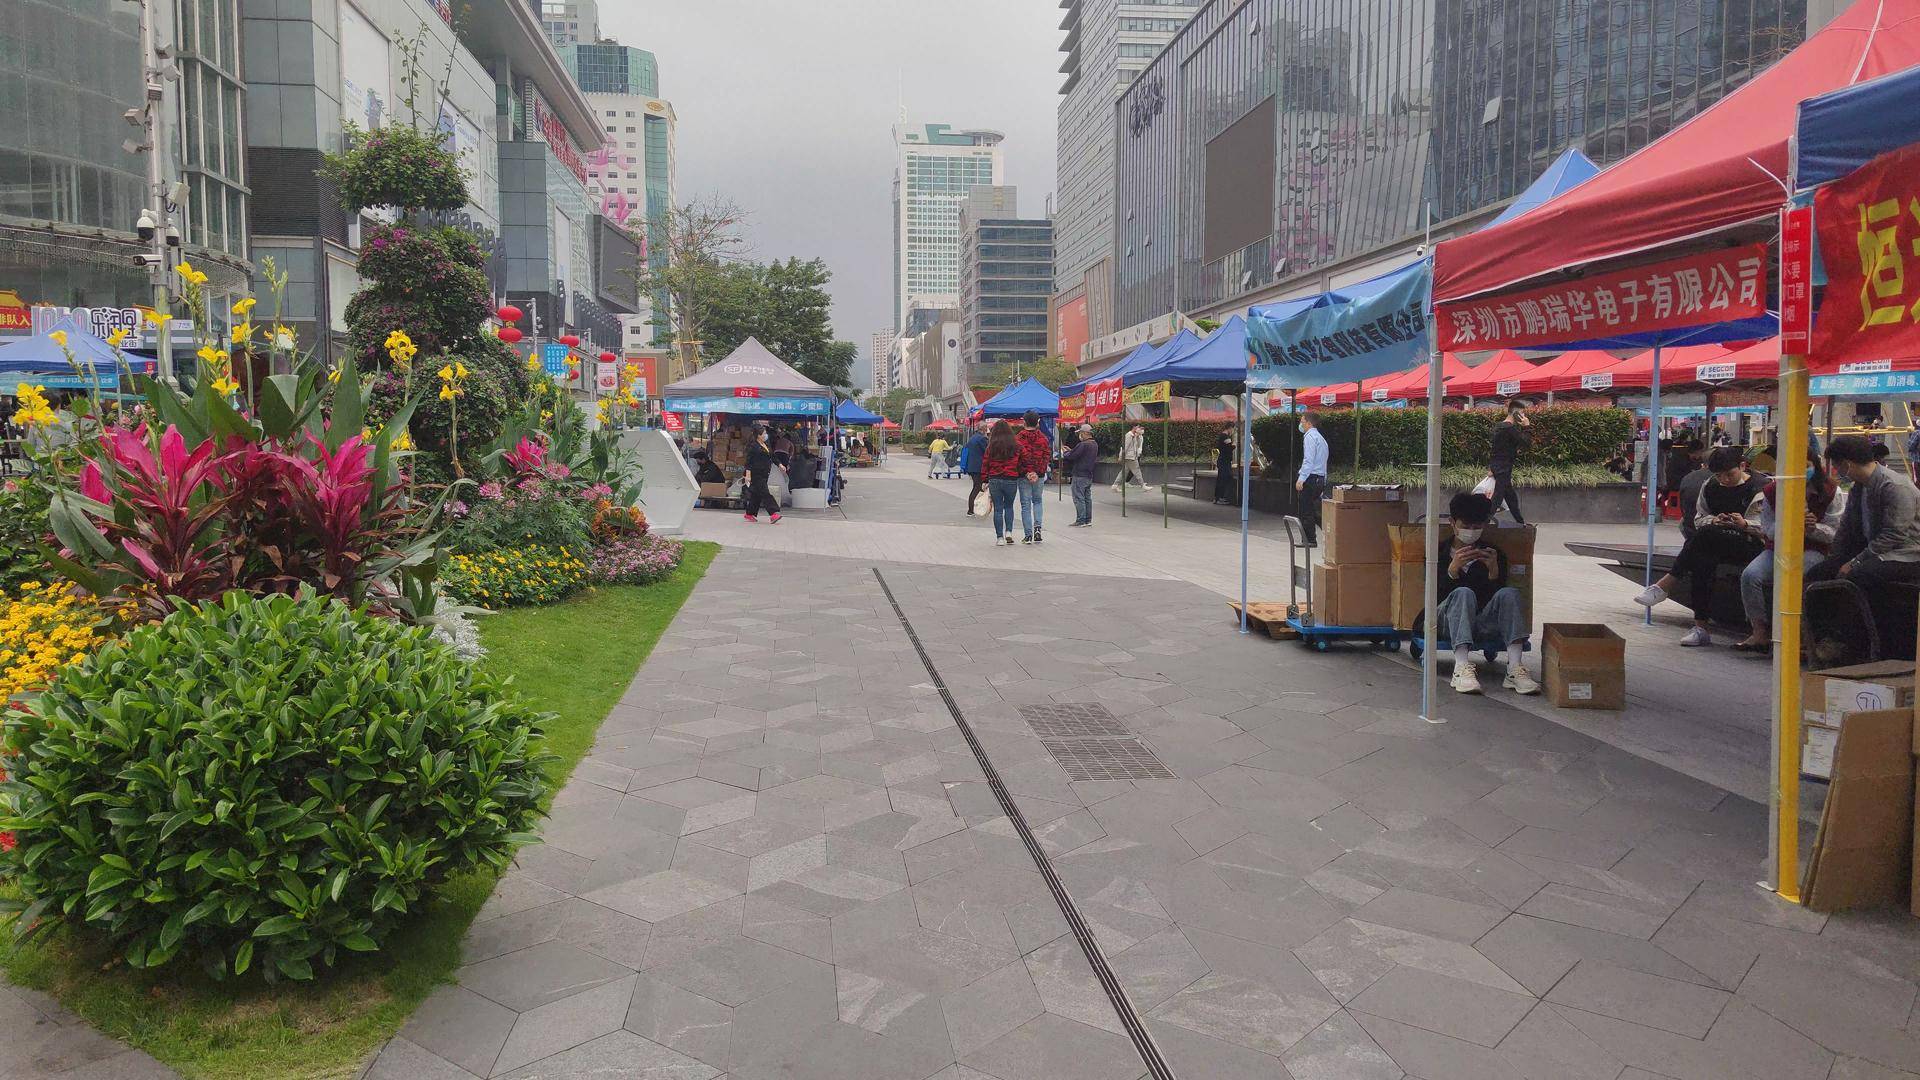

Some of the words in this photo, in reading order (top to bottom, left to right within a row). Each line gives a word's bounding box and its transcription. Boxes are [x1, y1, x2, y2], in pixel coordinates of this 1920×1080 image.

[1452, 256, 1761, 345] 深圳市鹏瑞华电子有限公司
[1857, 196, 1920, 332] 恒
